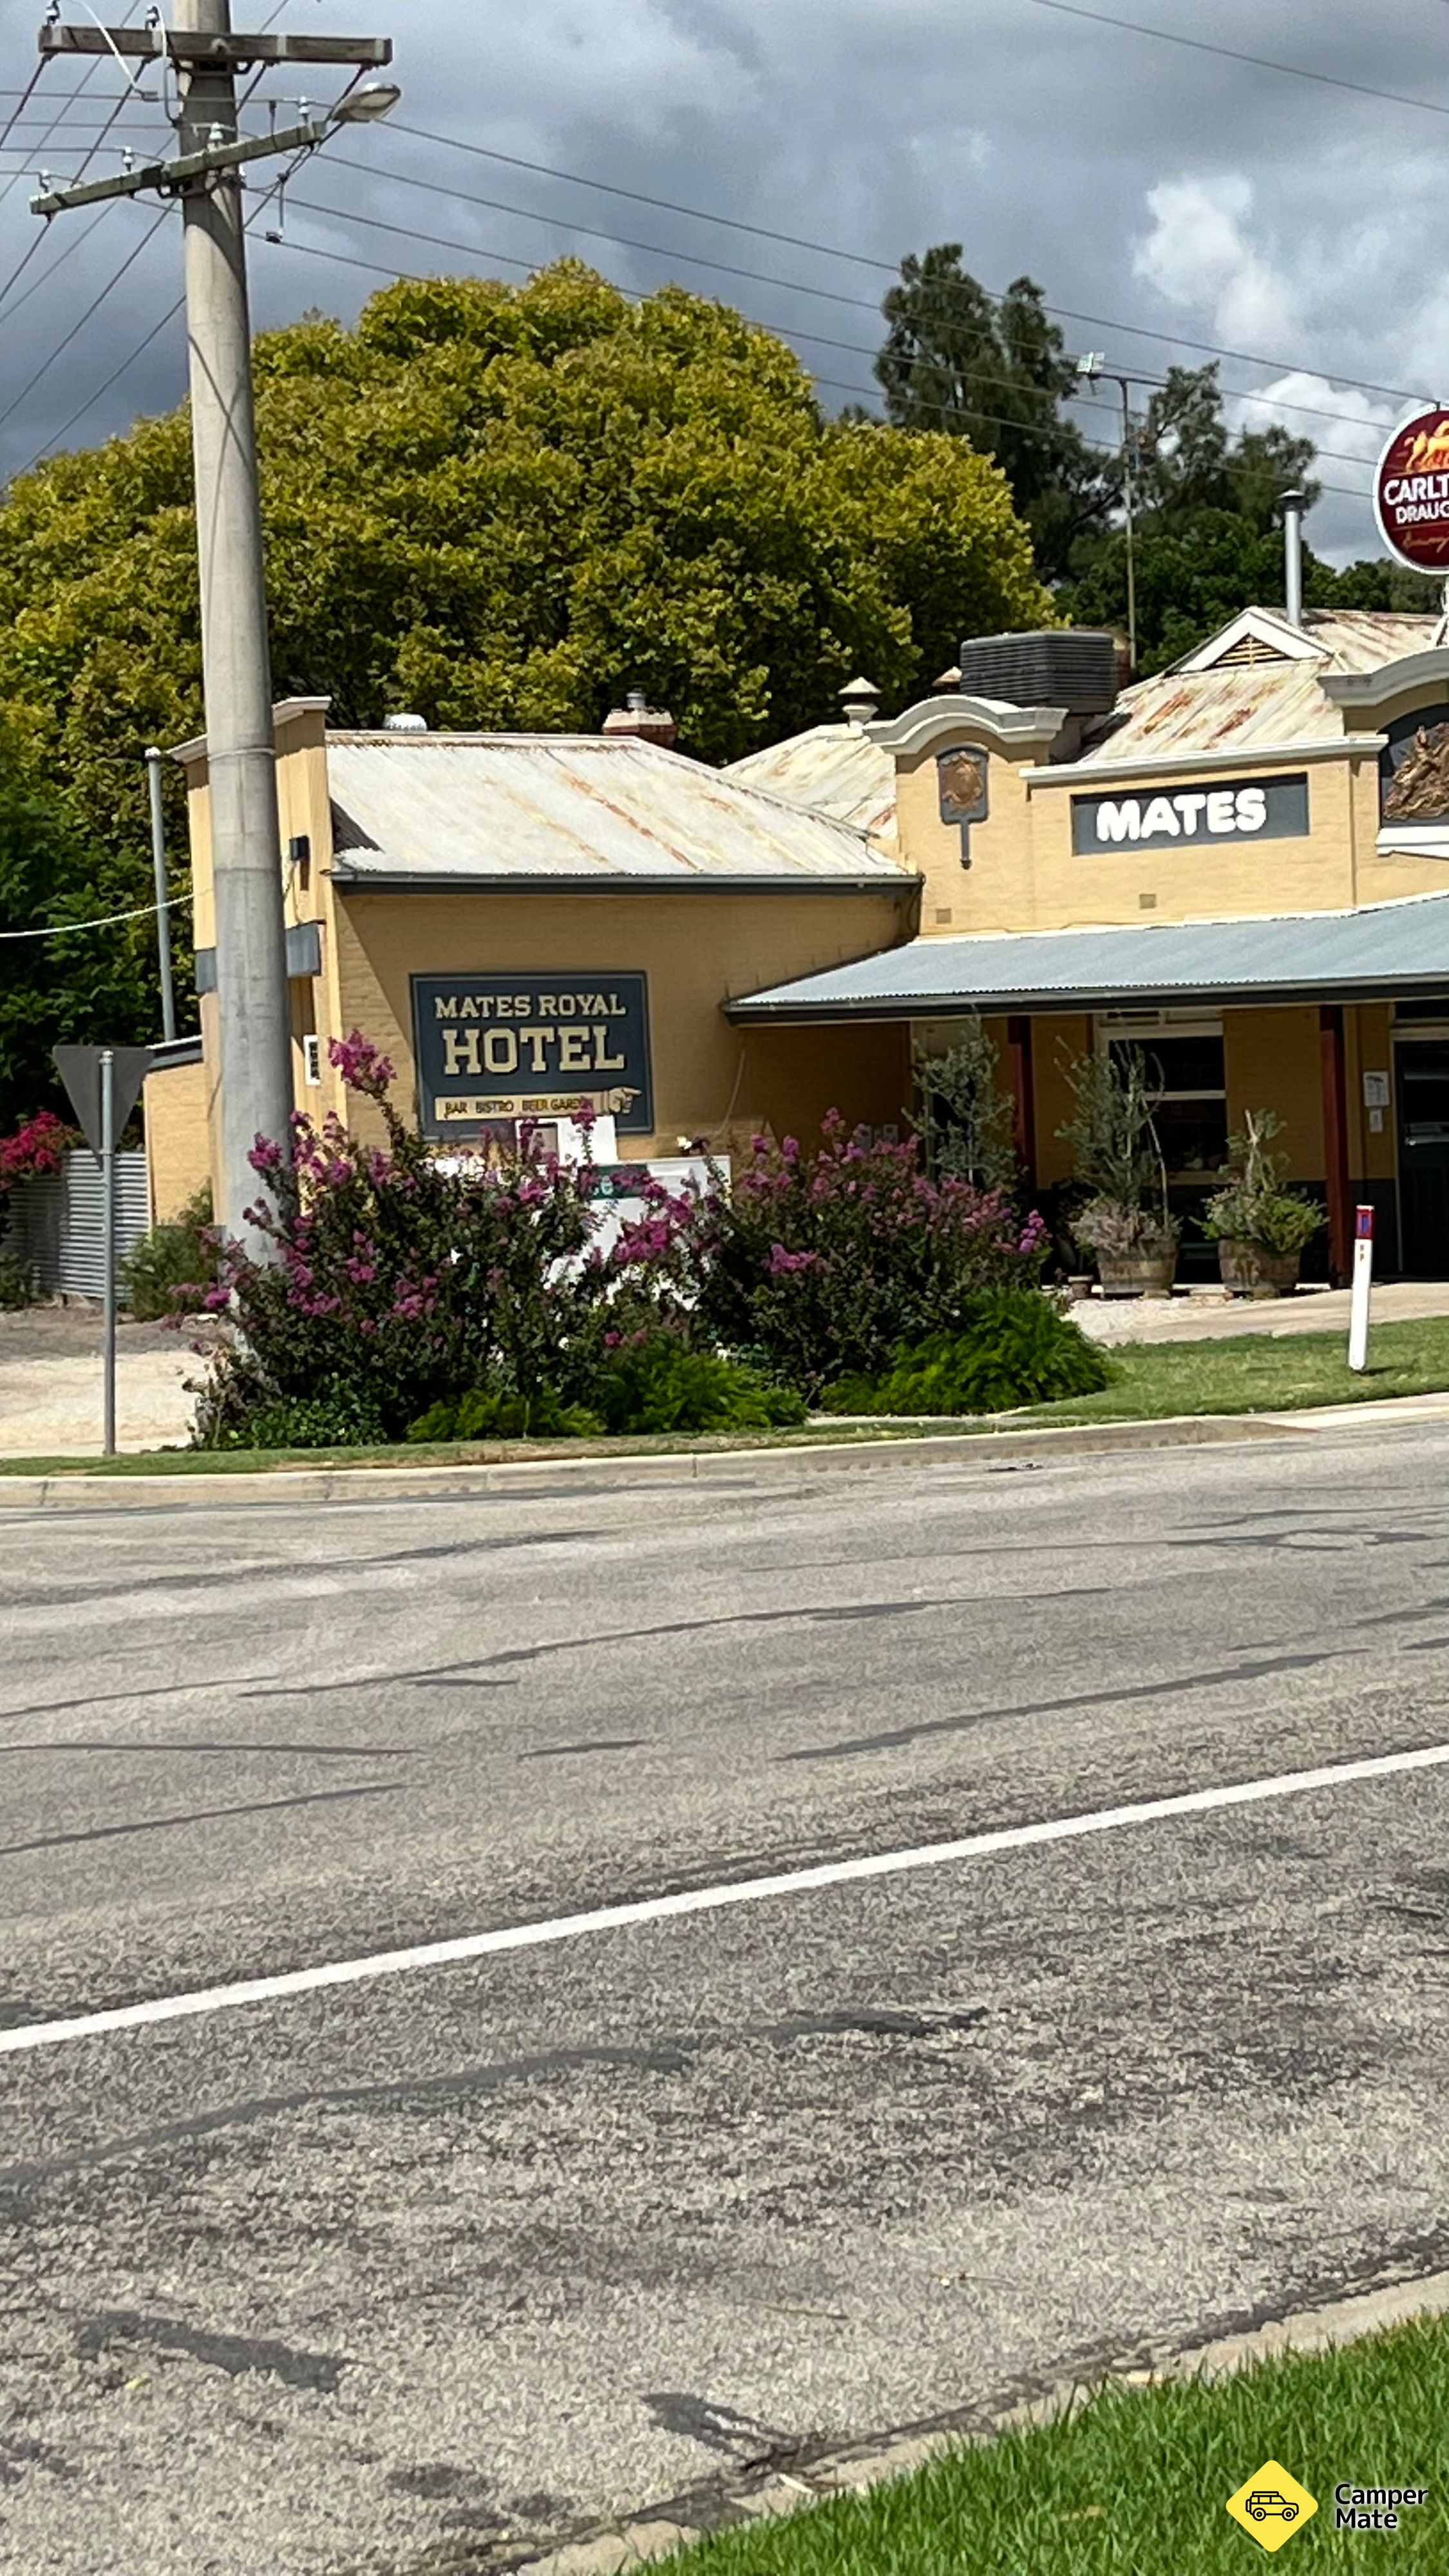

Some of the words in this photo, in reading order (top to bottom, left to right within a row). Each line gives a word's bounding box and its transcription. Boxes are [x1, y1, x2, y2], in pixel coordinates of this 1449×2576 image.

[1097, 787, 1267, 842] MATES
[435, 995, 532, 1020] MATES
[538, 993, 627, 1017] ROYAL
[442, 1025, 625, 1075] HOTEL
[445, 1102, 468, 1114] BAR
[476, 1100, 514, 1113] BISTRO
[551, 1097, 594, 1110] GARD
